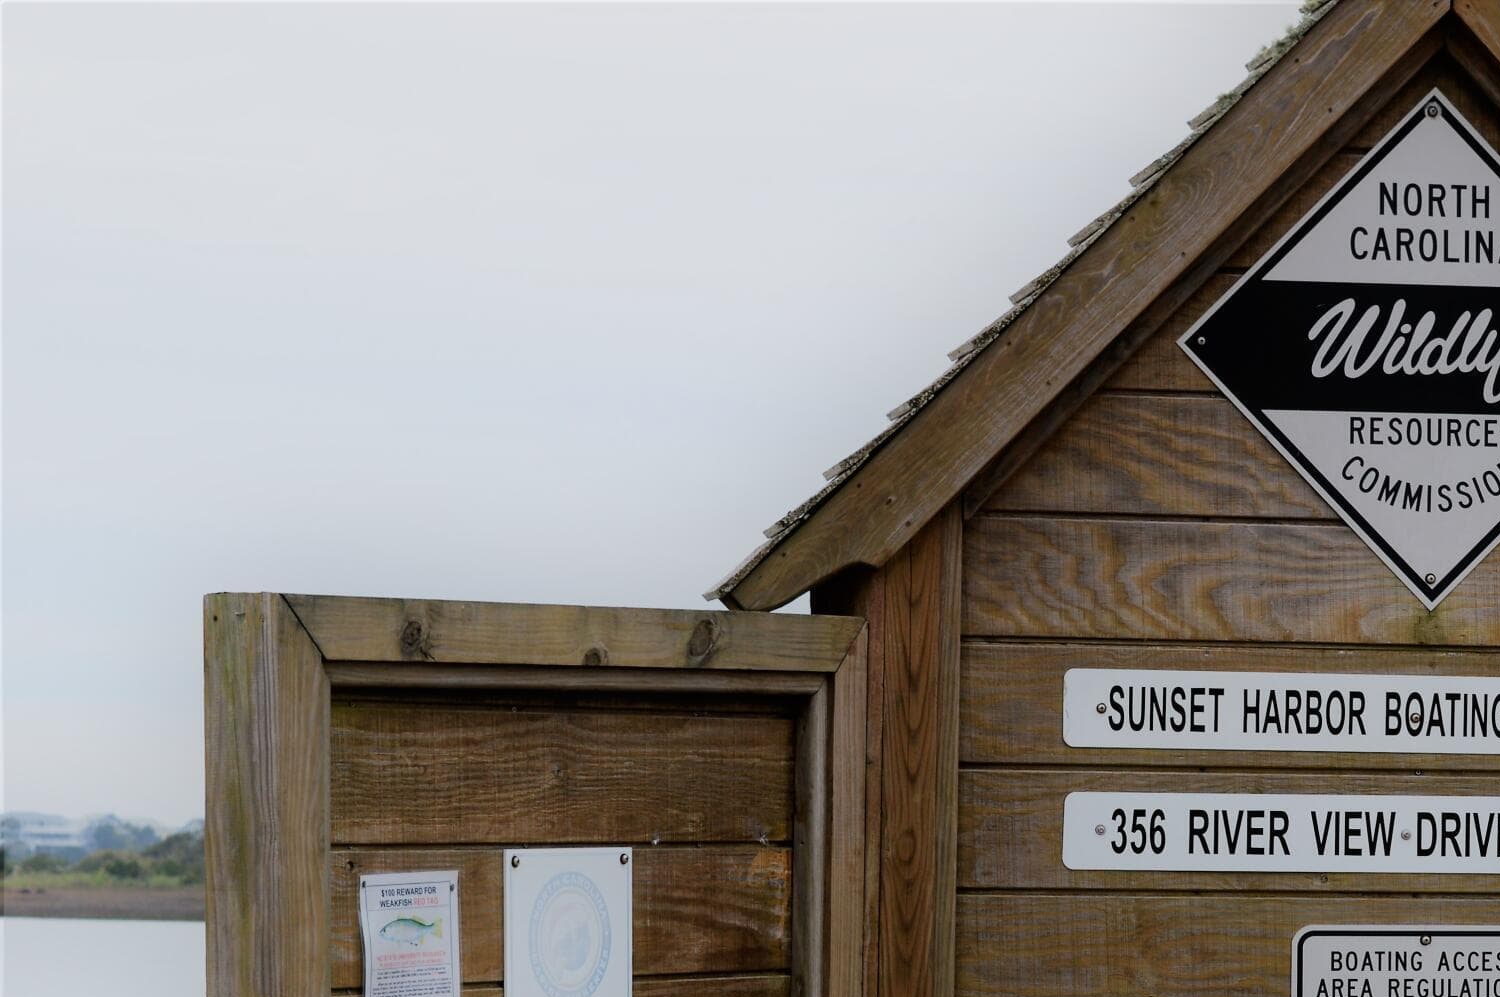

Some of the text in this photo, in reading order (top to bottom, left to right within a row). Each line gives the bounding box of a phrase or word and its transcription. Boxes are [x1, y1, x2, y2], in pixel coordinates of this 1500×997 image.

[1378, 182, 1491, 219] NORTH
[1108, 686, 1225, 733] SUNSET
[1242, 689, 1368, 736] HARBOR
[1110, 808, 1167, 855] 356
[1188, 809, 1291, 856] RIVER
[1311, 810, 1396, 857] VIEW
[380, 899, 412, 908] WEAKFISH
[397, 888, 424, 896] REWARD
[1331, 951, 1423, 971] BOATING
